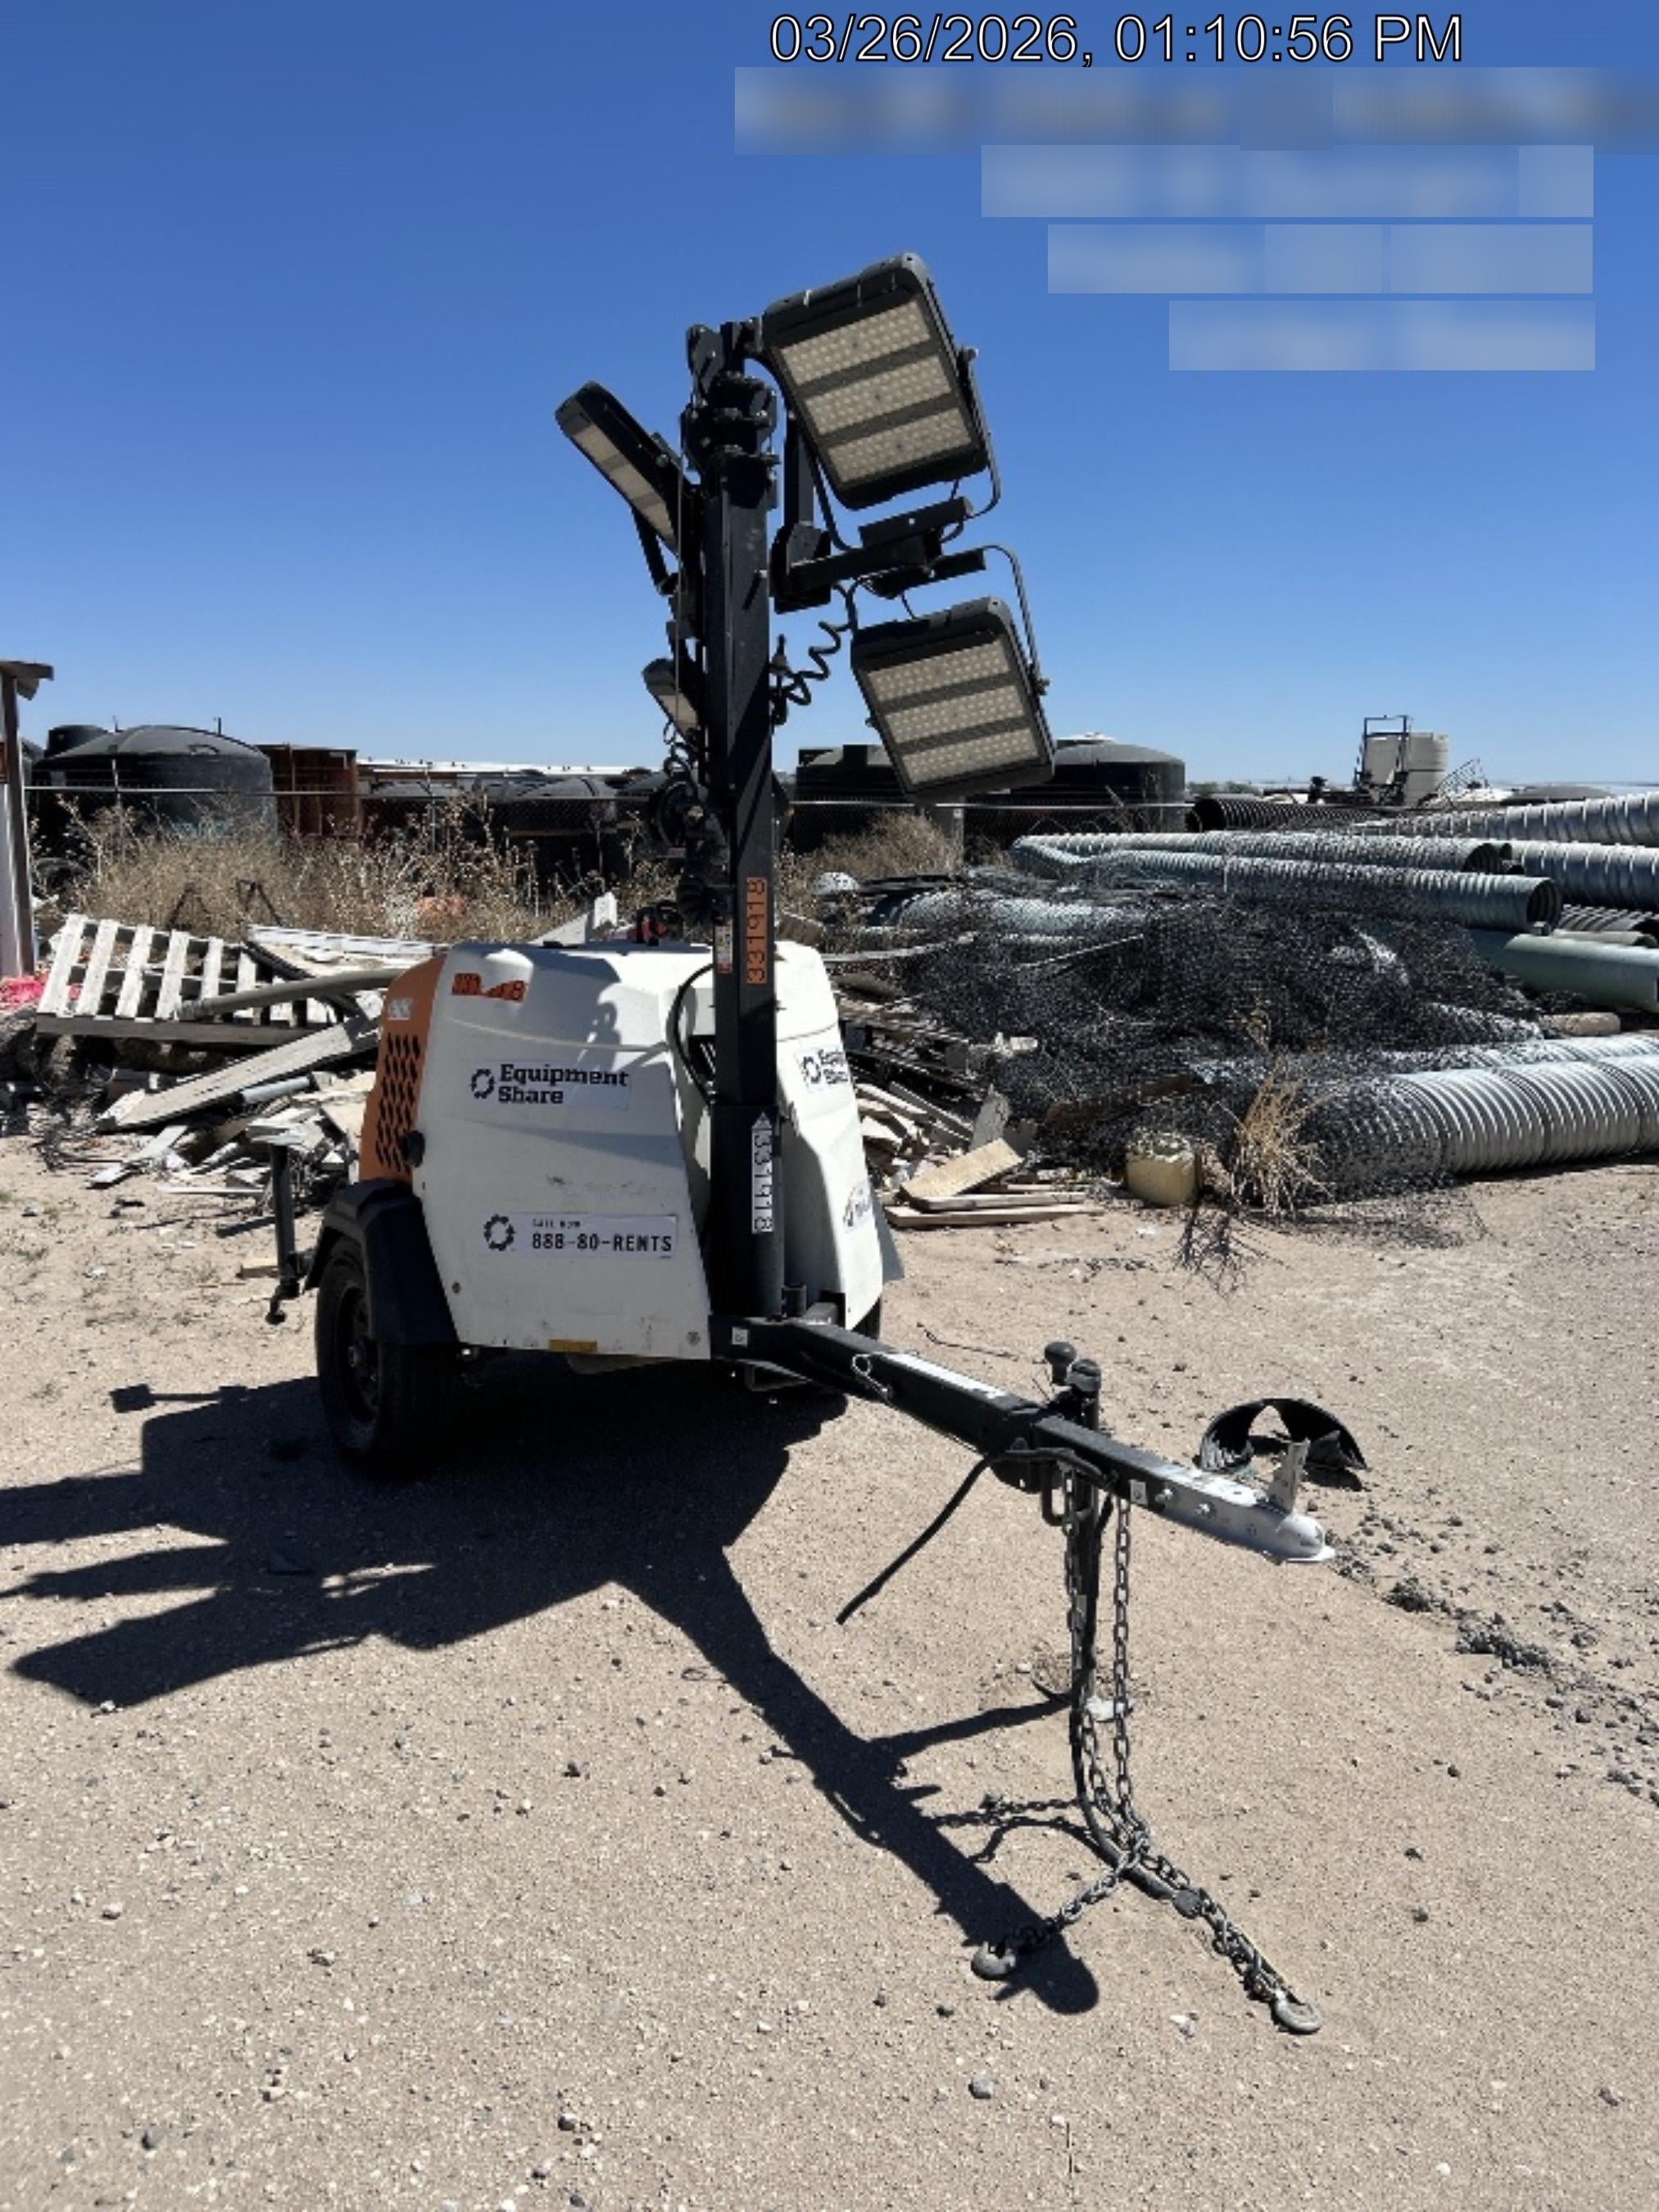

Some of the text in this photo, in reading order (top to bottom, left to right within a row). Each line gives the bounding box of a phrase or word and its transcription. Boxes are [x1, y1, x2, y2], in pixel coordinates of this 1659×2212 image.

[746, 879, 765, 981] 331918
[498, 1063, 630, 1086] Equipment
[498, 1086, 564, 1104] Share
[533, 1232, 673, 1252] 888-80-RENTS
